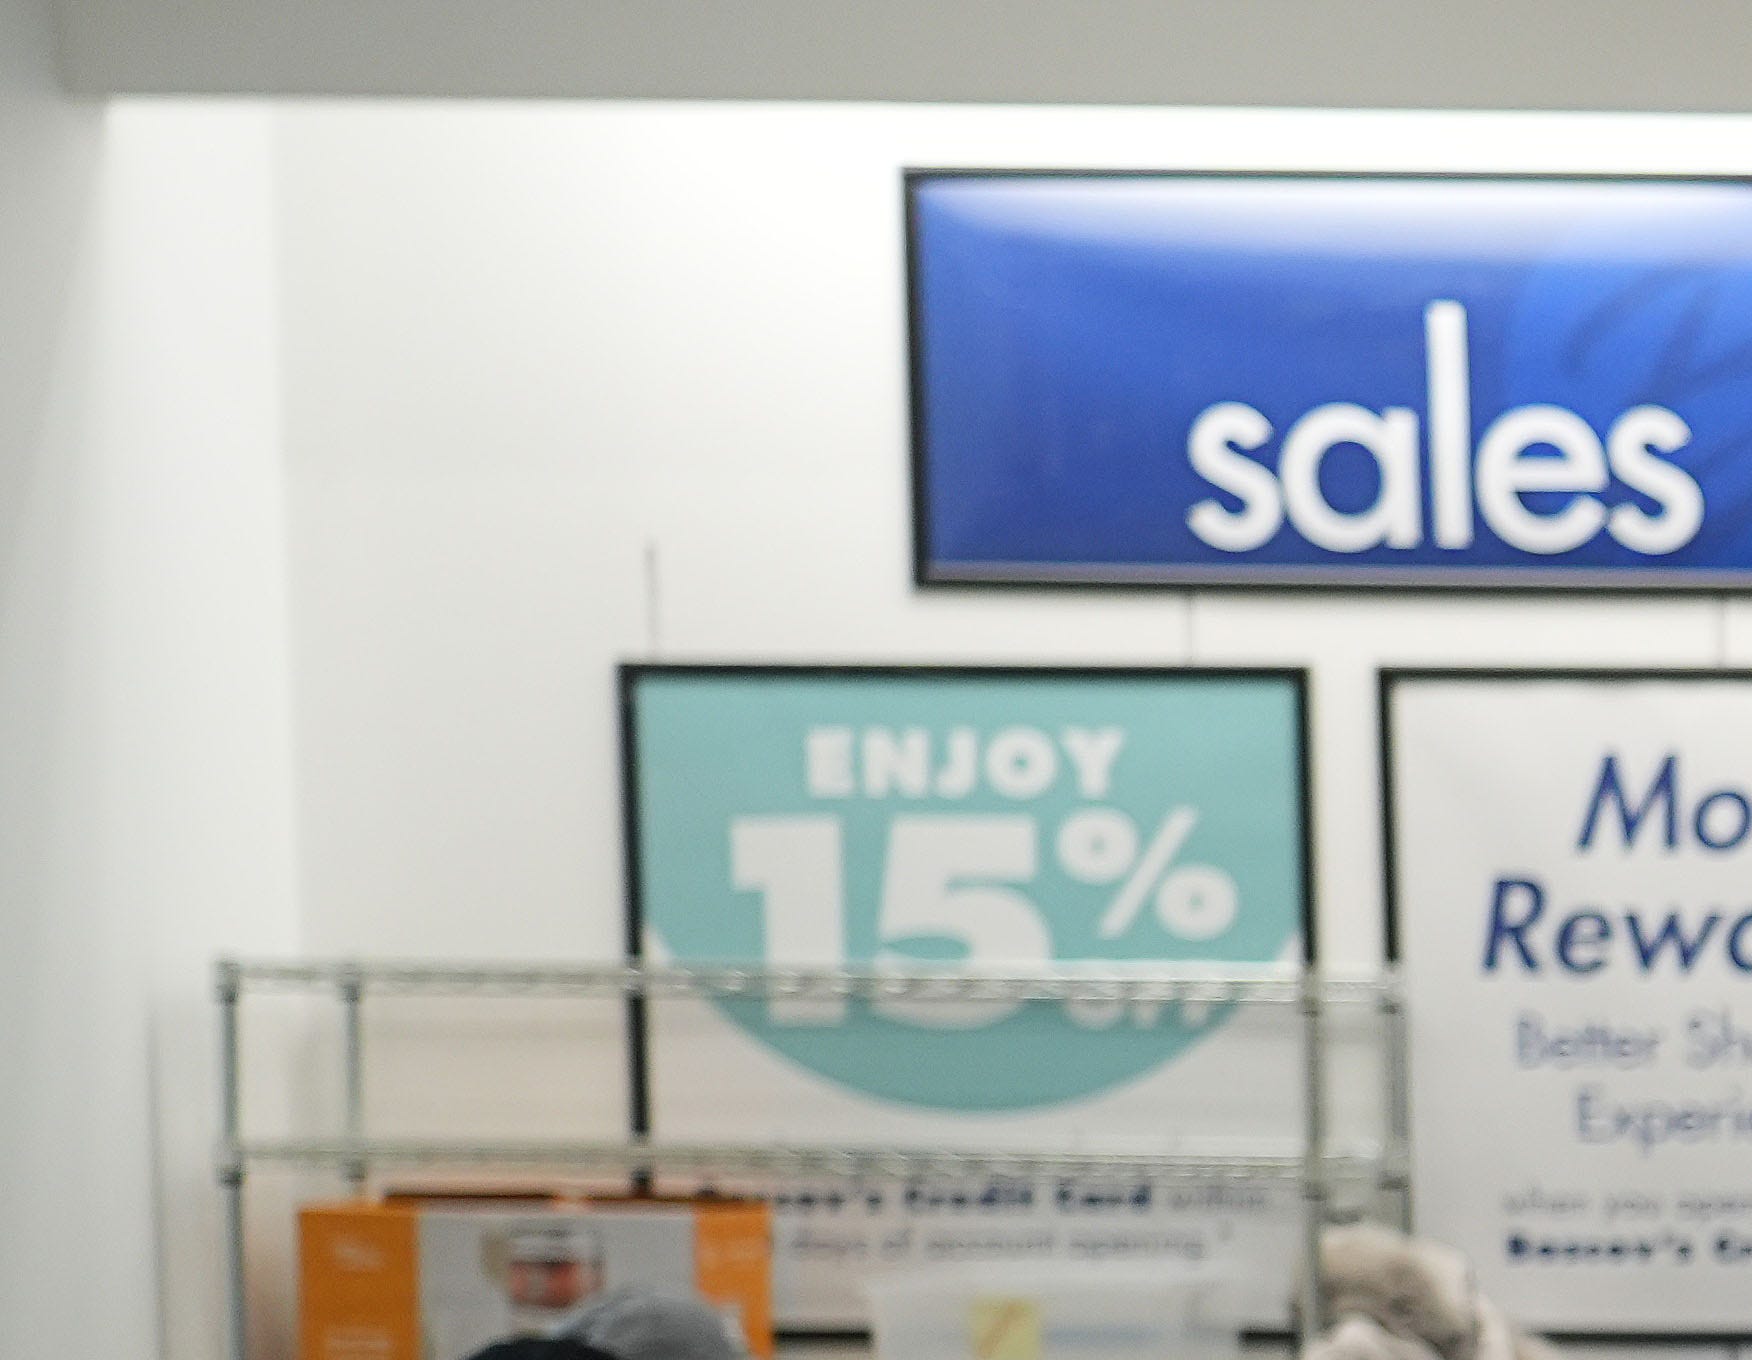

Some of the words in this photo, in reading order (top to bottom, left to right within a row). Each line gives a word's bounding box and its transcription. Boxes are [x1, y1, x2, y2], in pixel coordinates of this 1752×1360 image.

[1186, 299, 1706, 556] sales
[805, 725, 1127, 799] ENJOY
[729, 804, 1241, 1030] 15%
[1515, 1009, 1658, 1069] Better
